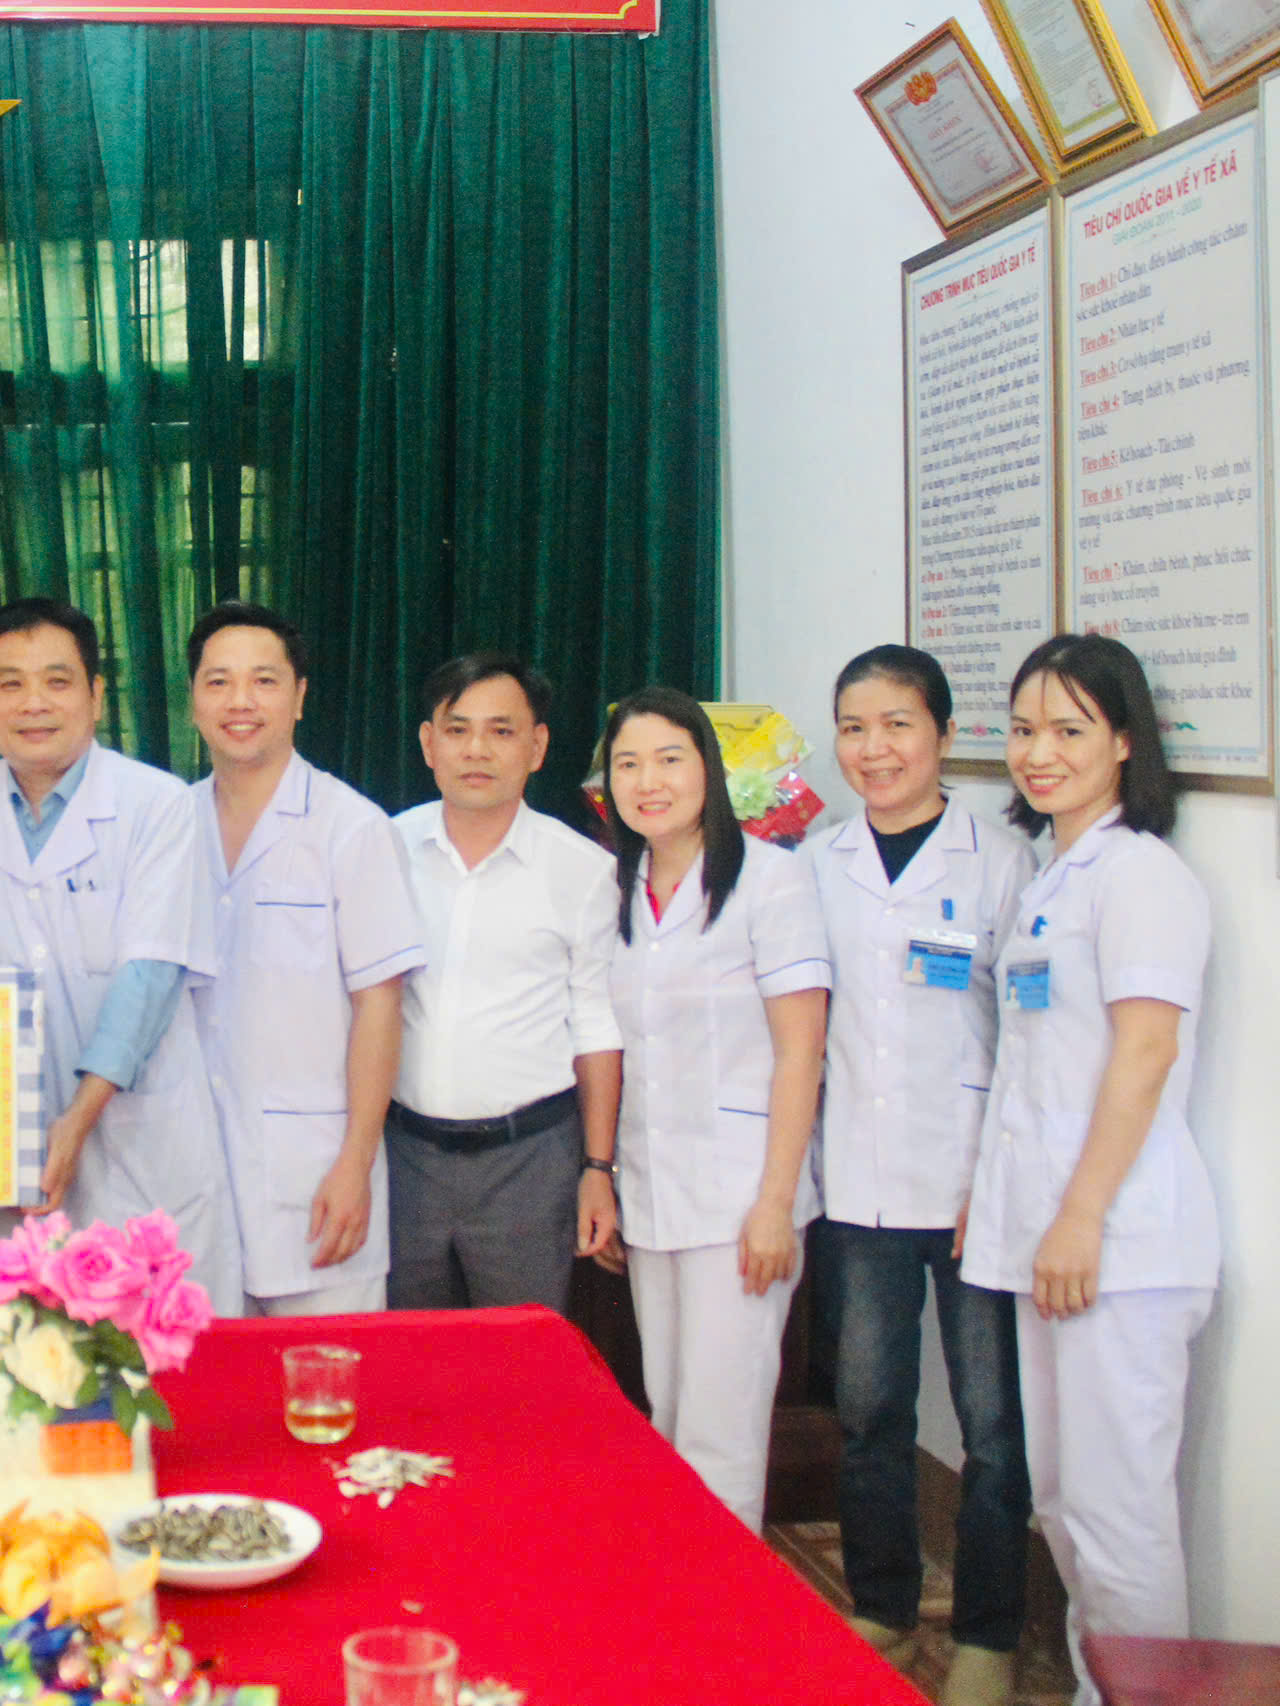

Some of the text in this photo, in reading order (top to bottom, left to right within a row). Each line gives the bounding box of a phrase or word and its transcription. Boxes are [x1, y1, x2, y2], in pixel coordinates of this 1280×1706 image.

[1124, 188, 1153, 221] QUỐC
[1155, 184, 1173, 207] GIA
[1193, 170, 1201, 190] Y
